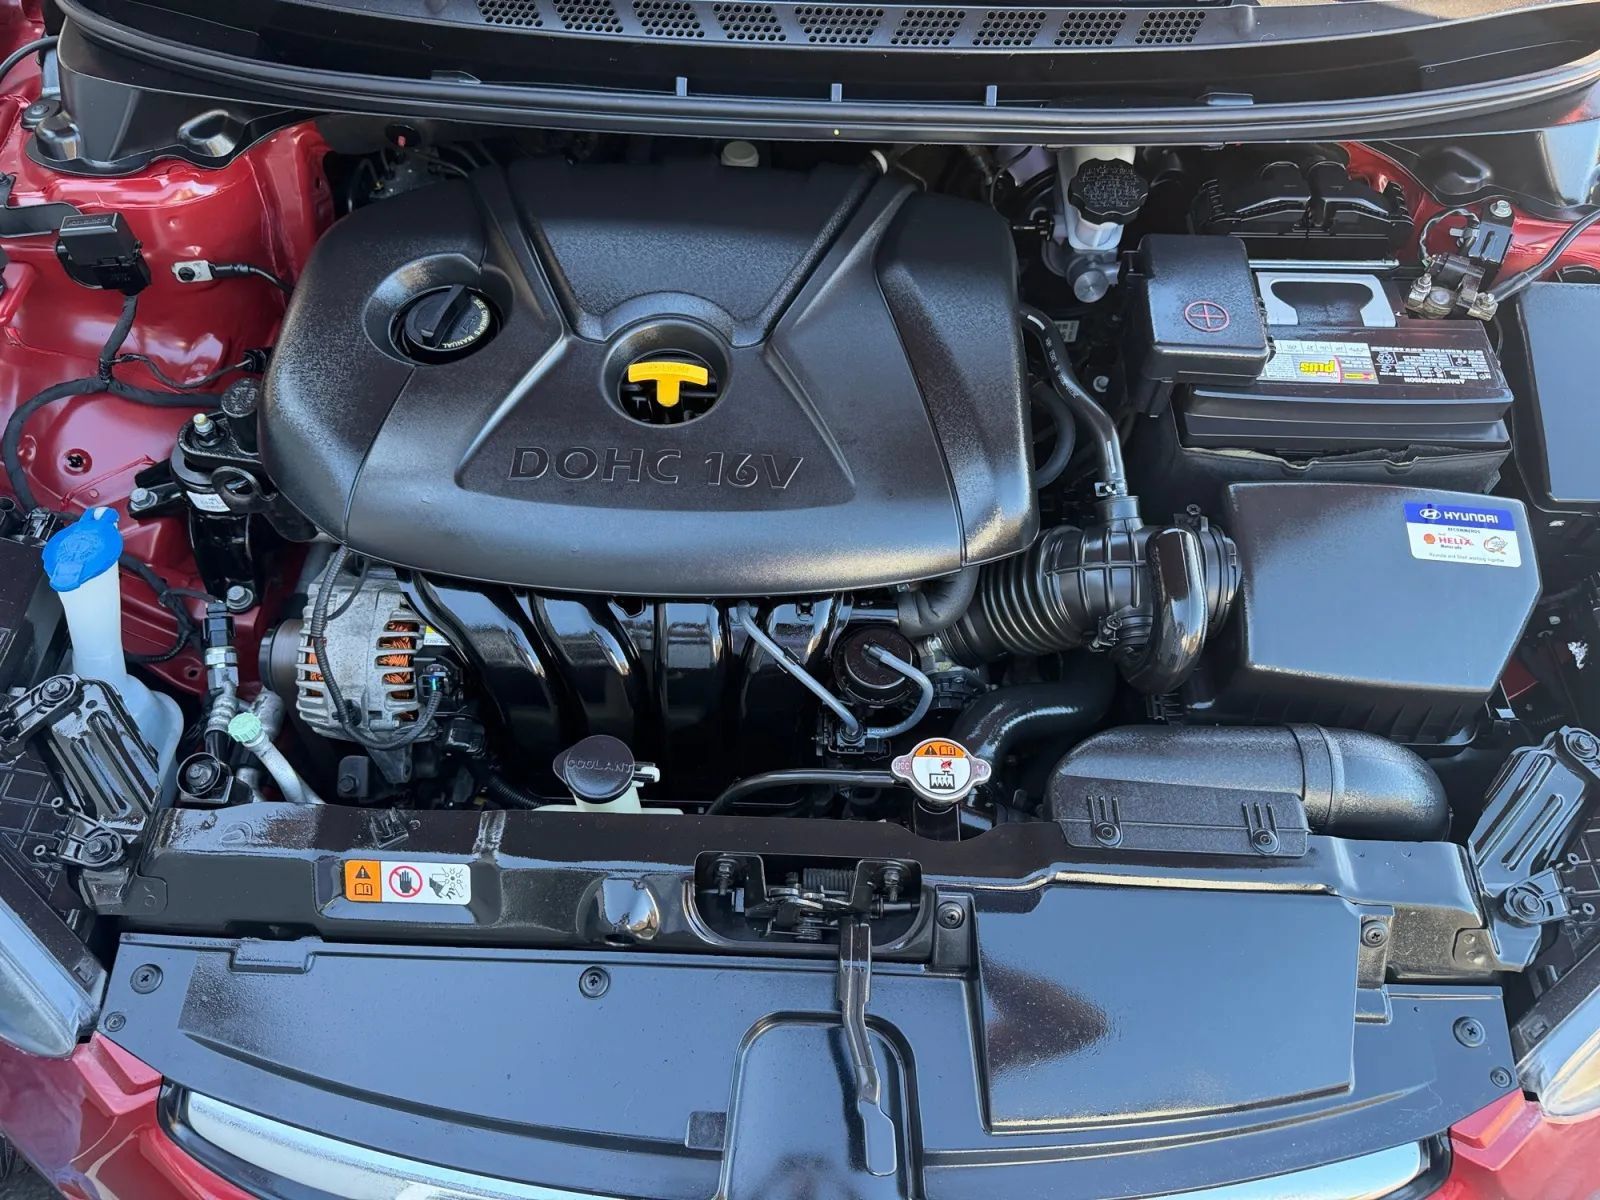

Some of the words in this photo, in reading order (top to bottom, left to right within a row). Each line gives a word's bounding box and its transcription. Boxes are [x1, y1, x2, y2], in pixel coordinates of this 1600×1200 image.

[441, 335, 474, 349] MANUAL
[507, 446, 682, 484] DOHC
[704, 452, 804, 489] 16V
[1443, 511, 1499, 524] HYUNDAI
[1438, 536, 1473, 546] HELIX
[568, 760, 633, 774] COOLANT
